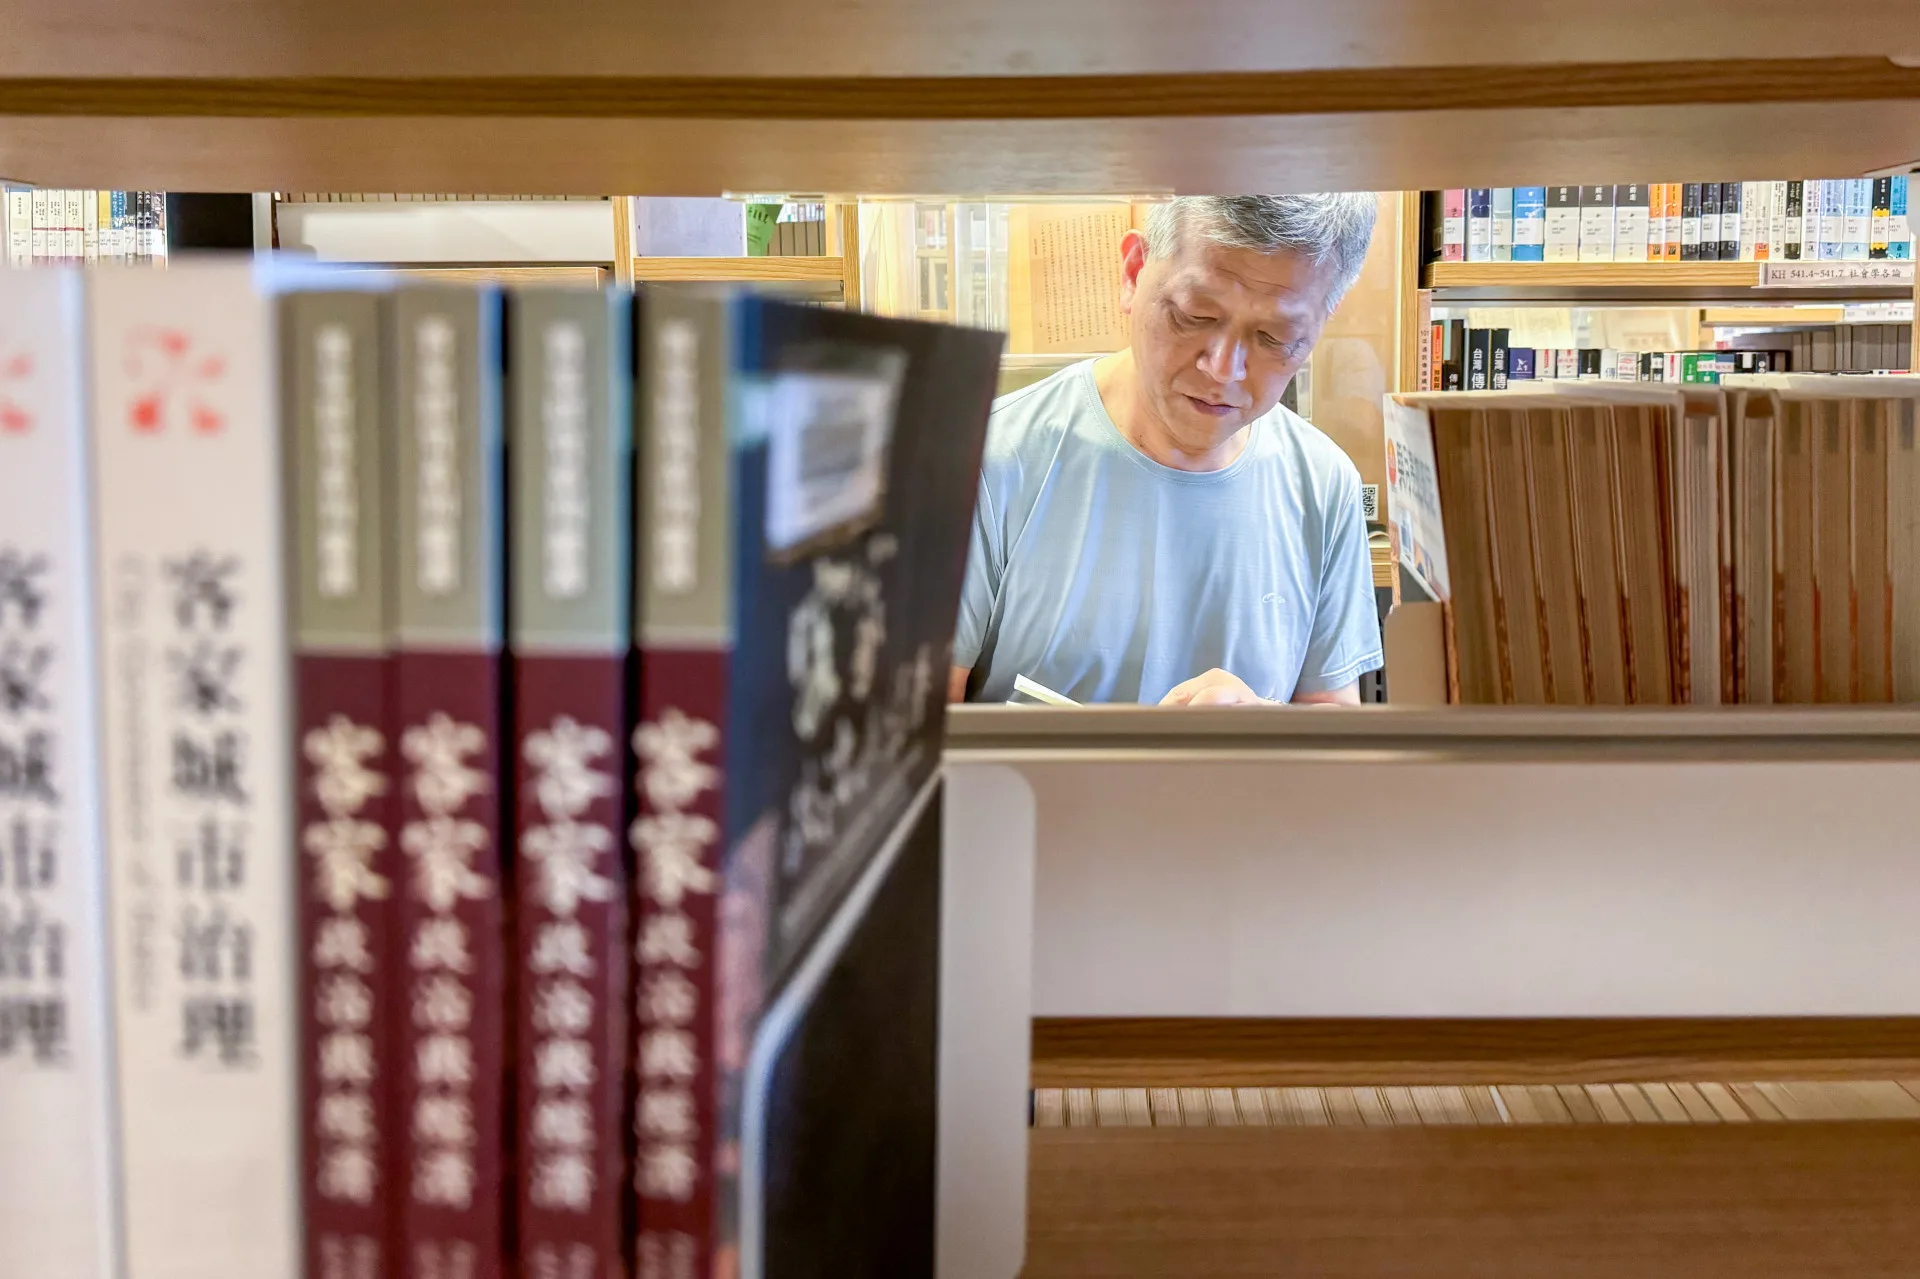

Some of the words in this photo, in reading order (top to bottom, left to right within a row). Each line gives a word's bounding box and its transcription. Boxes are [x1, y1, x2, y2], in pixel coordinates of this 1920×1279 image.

[1771, 270, 1786, 279] KH
[1790, 269, 1844, 278] 541.4~541.7
[1849, 268, 1901, 279] 社會學各論
